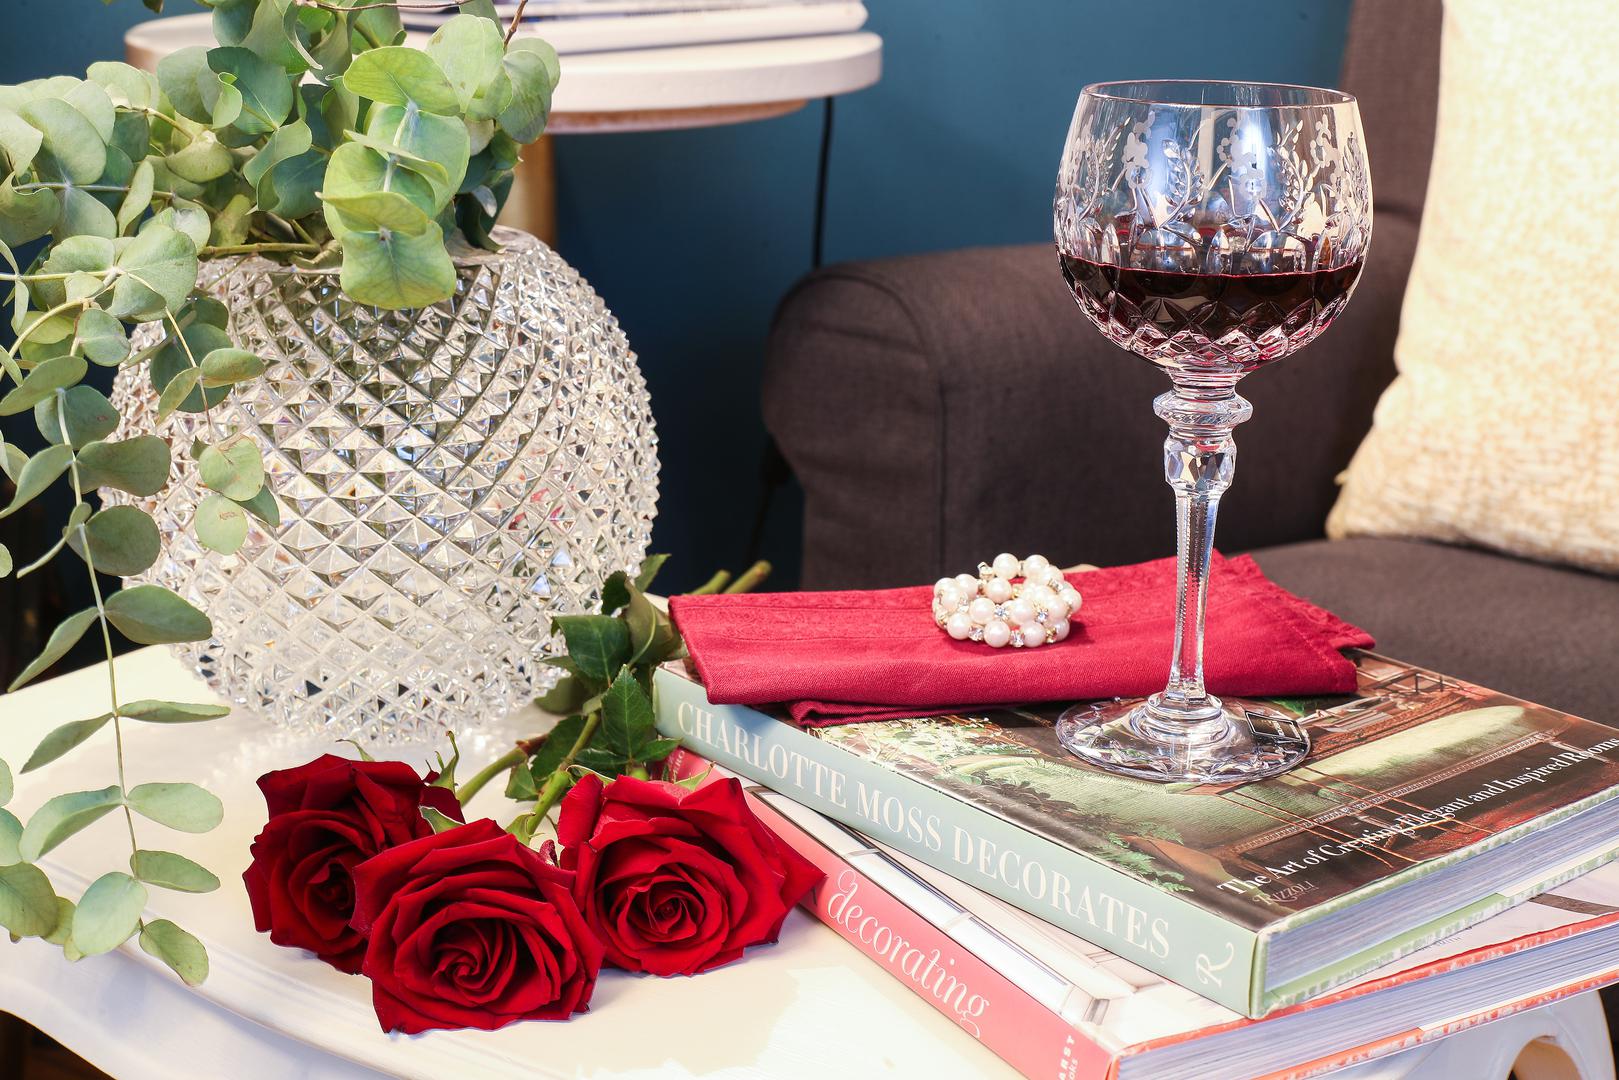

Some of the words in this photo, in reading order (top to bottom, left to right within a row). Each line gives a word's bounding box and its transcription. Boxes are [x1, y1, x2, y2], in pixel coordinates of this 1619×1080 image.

[677, 702, 847, 808] CHARLOTTE
[856, 780, 942, 851] MOSS
[952, 826, 1170, 958] DECORATES
[1217, 875, 1272, 894] The
[1265, 859, 1307, 880] Art
[1304, 849, 1330, 869] of
[1319, 819, 1417, 857] Creating
[1394, 797, 1474, 827] Elegant
[1468, 780, 1506, 801] and
[1493, 757, 1572, 789] Inspired
[1558, 738, 1619, 762] Rooms
[827, 869, 991, 1038] decorating
[1195, 942, 1235, 988] R
[1058, 1035, 1075, 1080] ARST
[1067, 1058, 1078, 1080] oks
